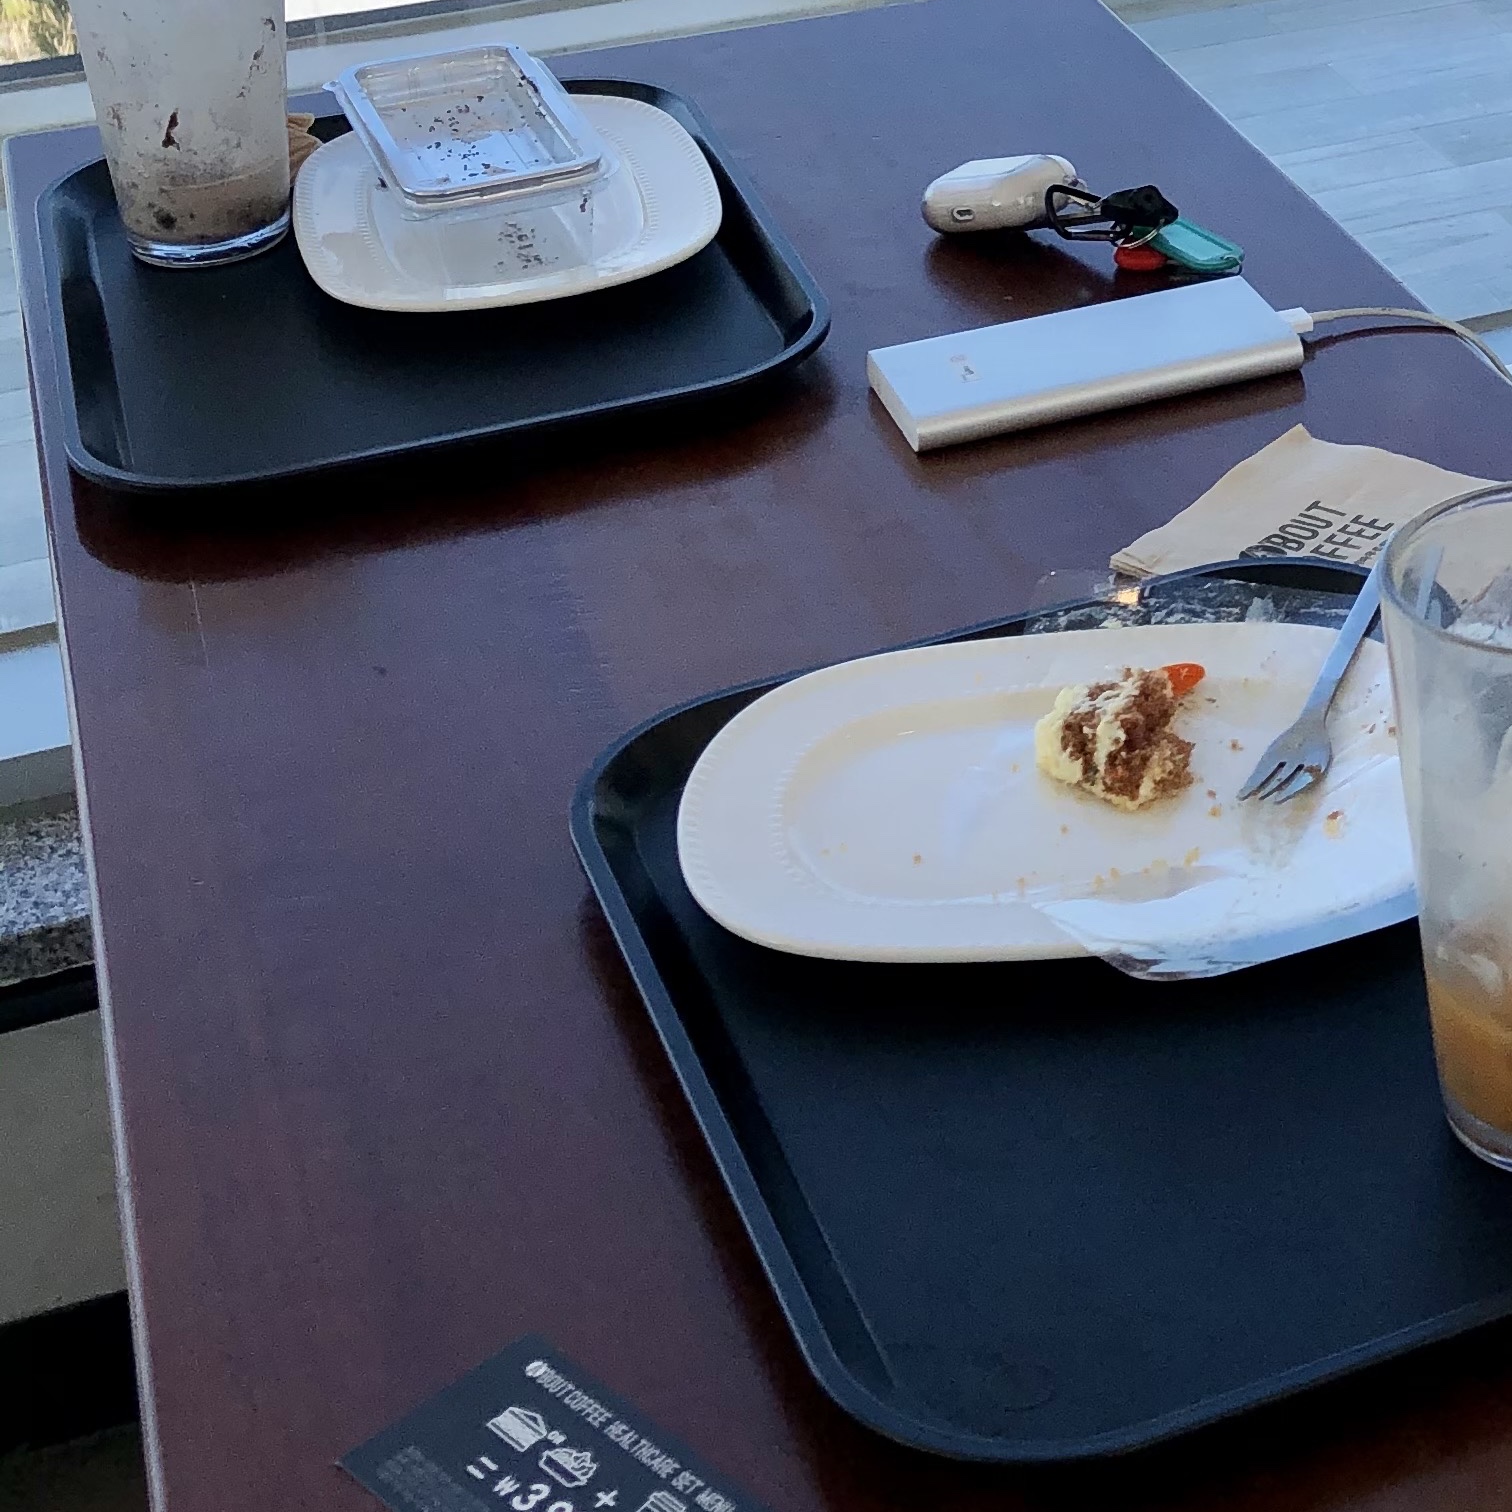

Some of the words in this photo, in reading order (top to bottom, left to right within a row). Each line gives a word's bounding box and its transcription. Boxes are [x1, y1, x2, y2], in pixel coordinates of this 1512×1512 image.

[1310, 514, 1395, 560] FFEE
[563, 1390, 613, 1429] COFFEE
[603, 1420, 681, 1479] HEALTHCARE
[671, 1469, 705, 1495] SET
